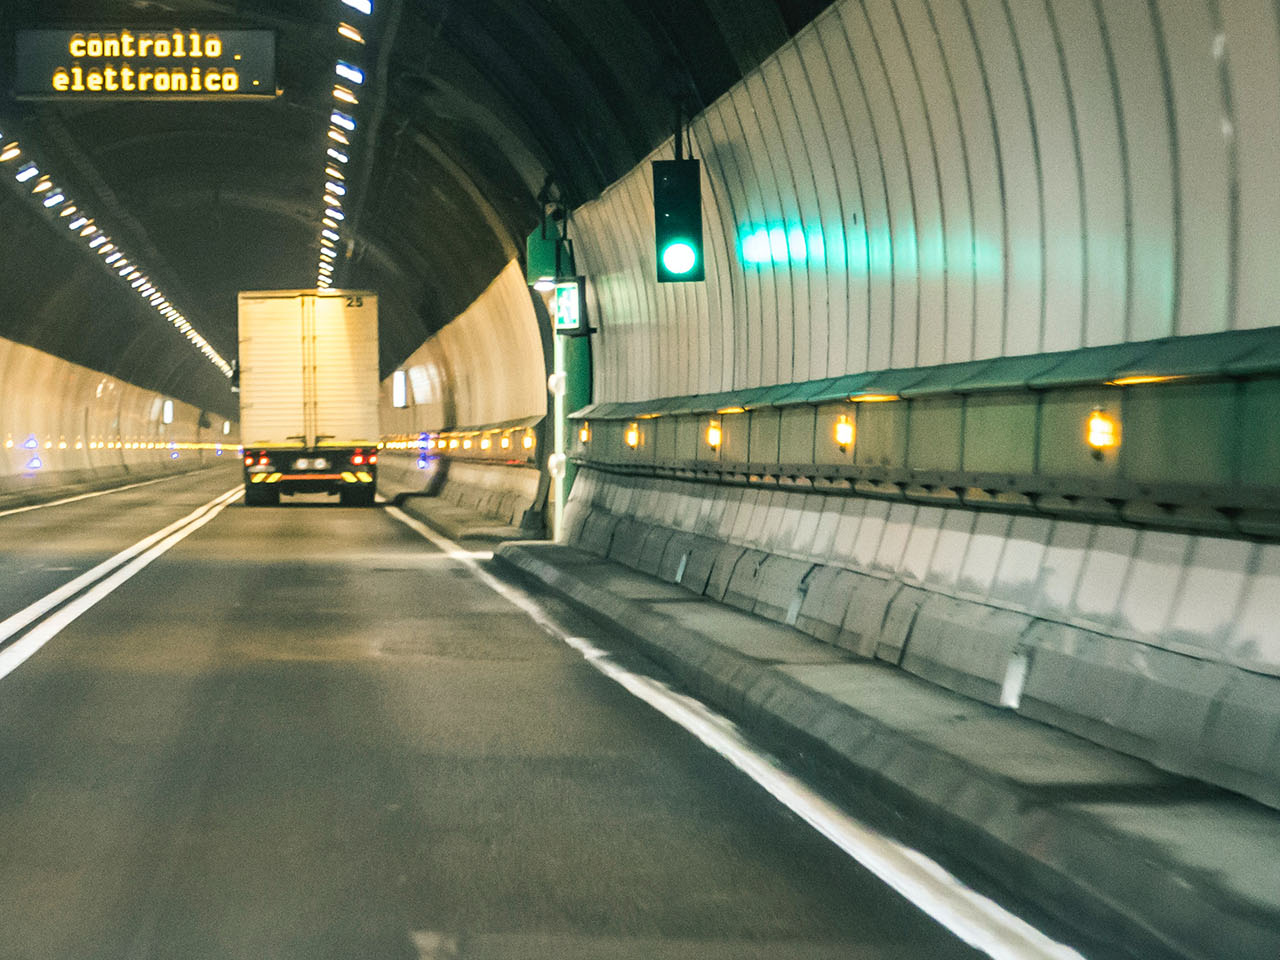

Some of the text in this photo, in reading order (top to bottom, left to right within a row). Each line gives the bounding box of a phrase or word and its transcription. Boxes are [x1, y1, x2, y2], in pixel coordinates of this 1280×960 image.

[69, 32, 222, 58] controllo
[52, 65, 240, 92] elettronico
[346, 296, 363, 308] 25
